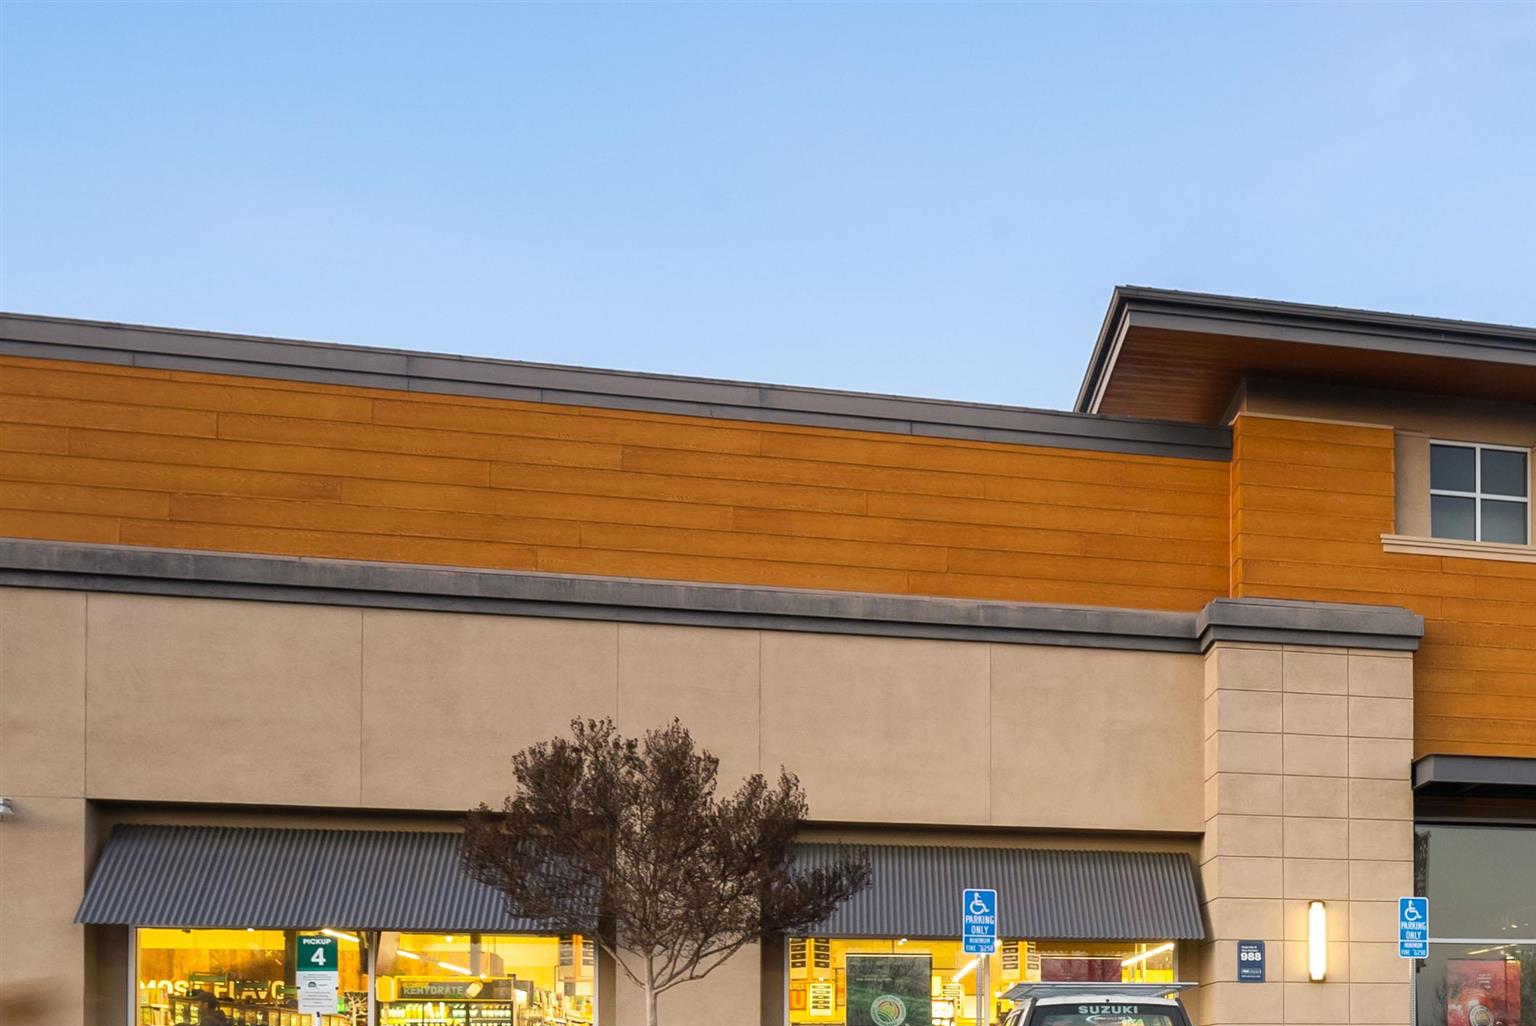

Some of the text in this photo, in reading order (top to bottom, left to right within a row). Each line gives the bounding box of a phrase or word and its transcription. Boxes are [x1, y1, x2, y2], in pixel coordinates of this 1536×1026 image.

[965, 915, 995, 925] PARKING
[971, 925, 989, 934] ONLY
[1401, 922, 1426, 931] PARKING
[1406, 931, 1422, 940] ONLY
[310, 947, 326, 966] 4
[1240, 952, 1262, 961] 988
[403, 985, 464, 995] REHYDRATE
[1078, 1005, 1139, 1014] SUZUKI
